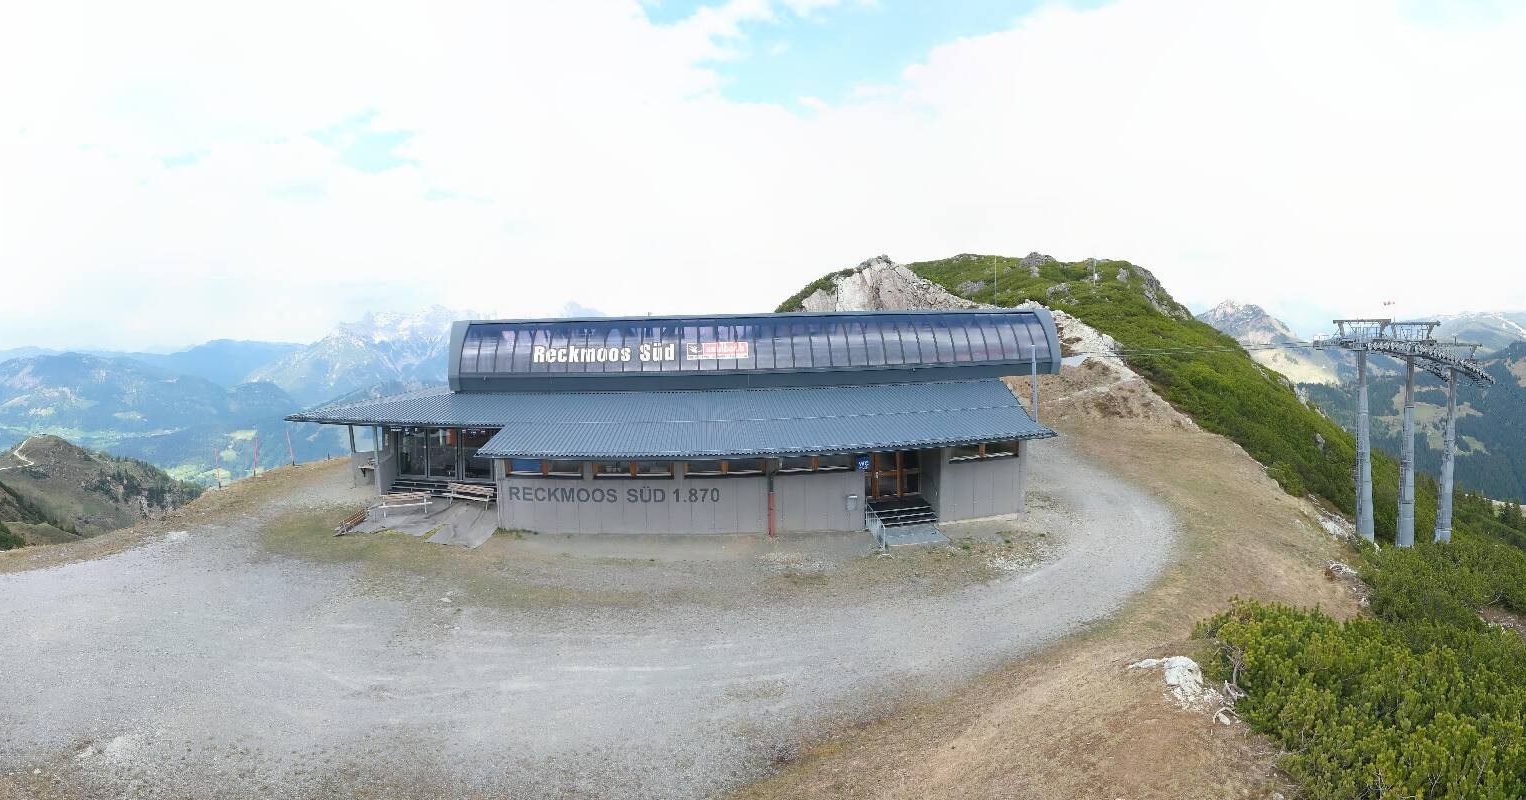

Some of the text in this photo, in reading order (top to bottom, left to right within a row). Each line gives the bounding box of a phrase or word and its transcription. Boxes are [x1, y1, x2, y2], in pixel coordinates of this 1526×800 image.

[533, 343, 675, 363] Reckmoos Süd
[508, 486, 720, 503] RECKMOOS SÜD 1.870
